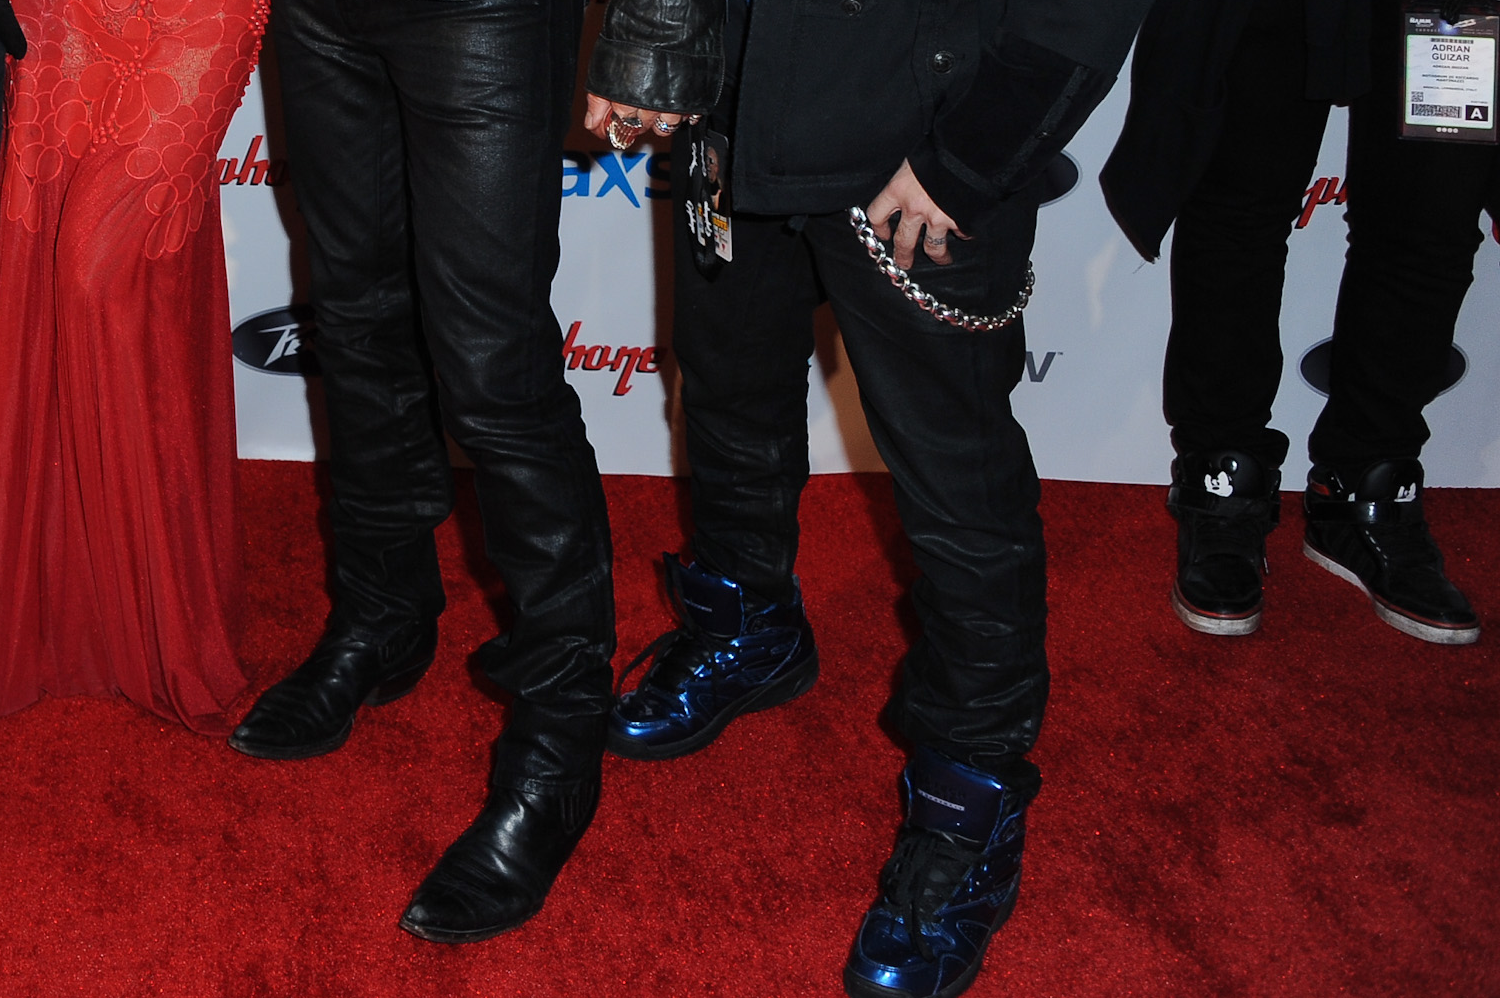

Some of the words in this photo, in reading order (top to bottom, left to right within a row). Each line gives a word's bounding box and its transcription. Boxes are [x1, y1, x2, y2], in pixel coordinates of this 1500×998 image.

[1431, 44, 1471, 53] ADRIAN
[1431, 52, 1470, 62] GUIZAR
[1470, 107, 1483, 120] A
